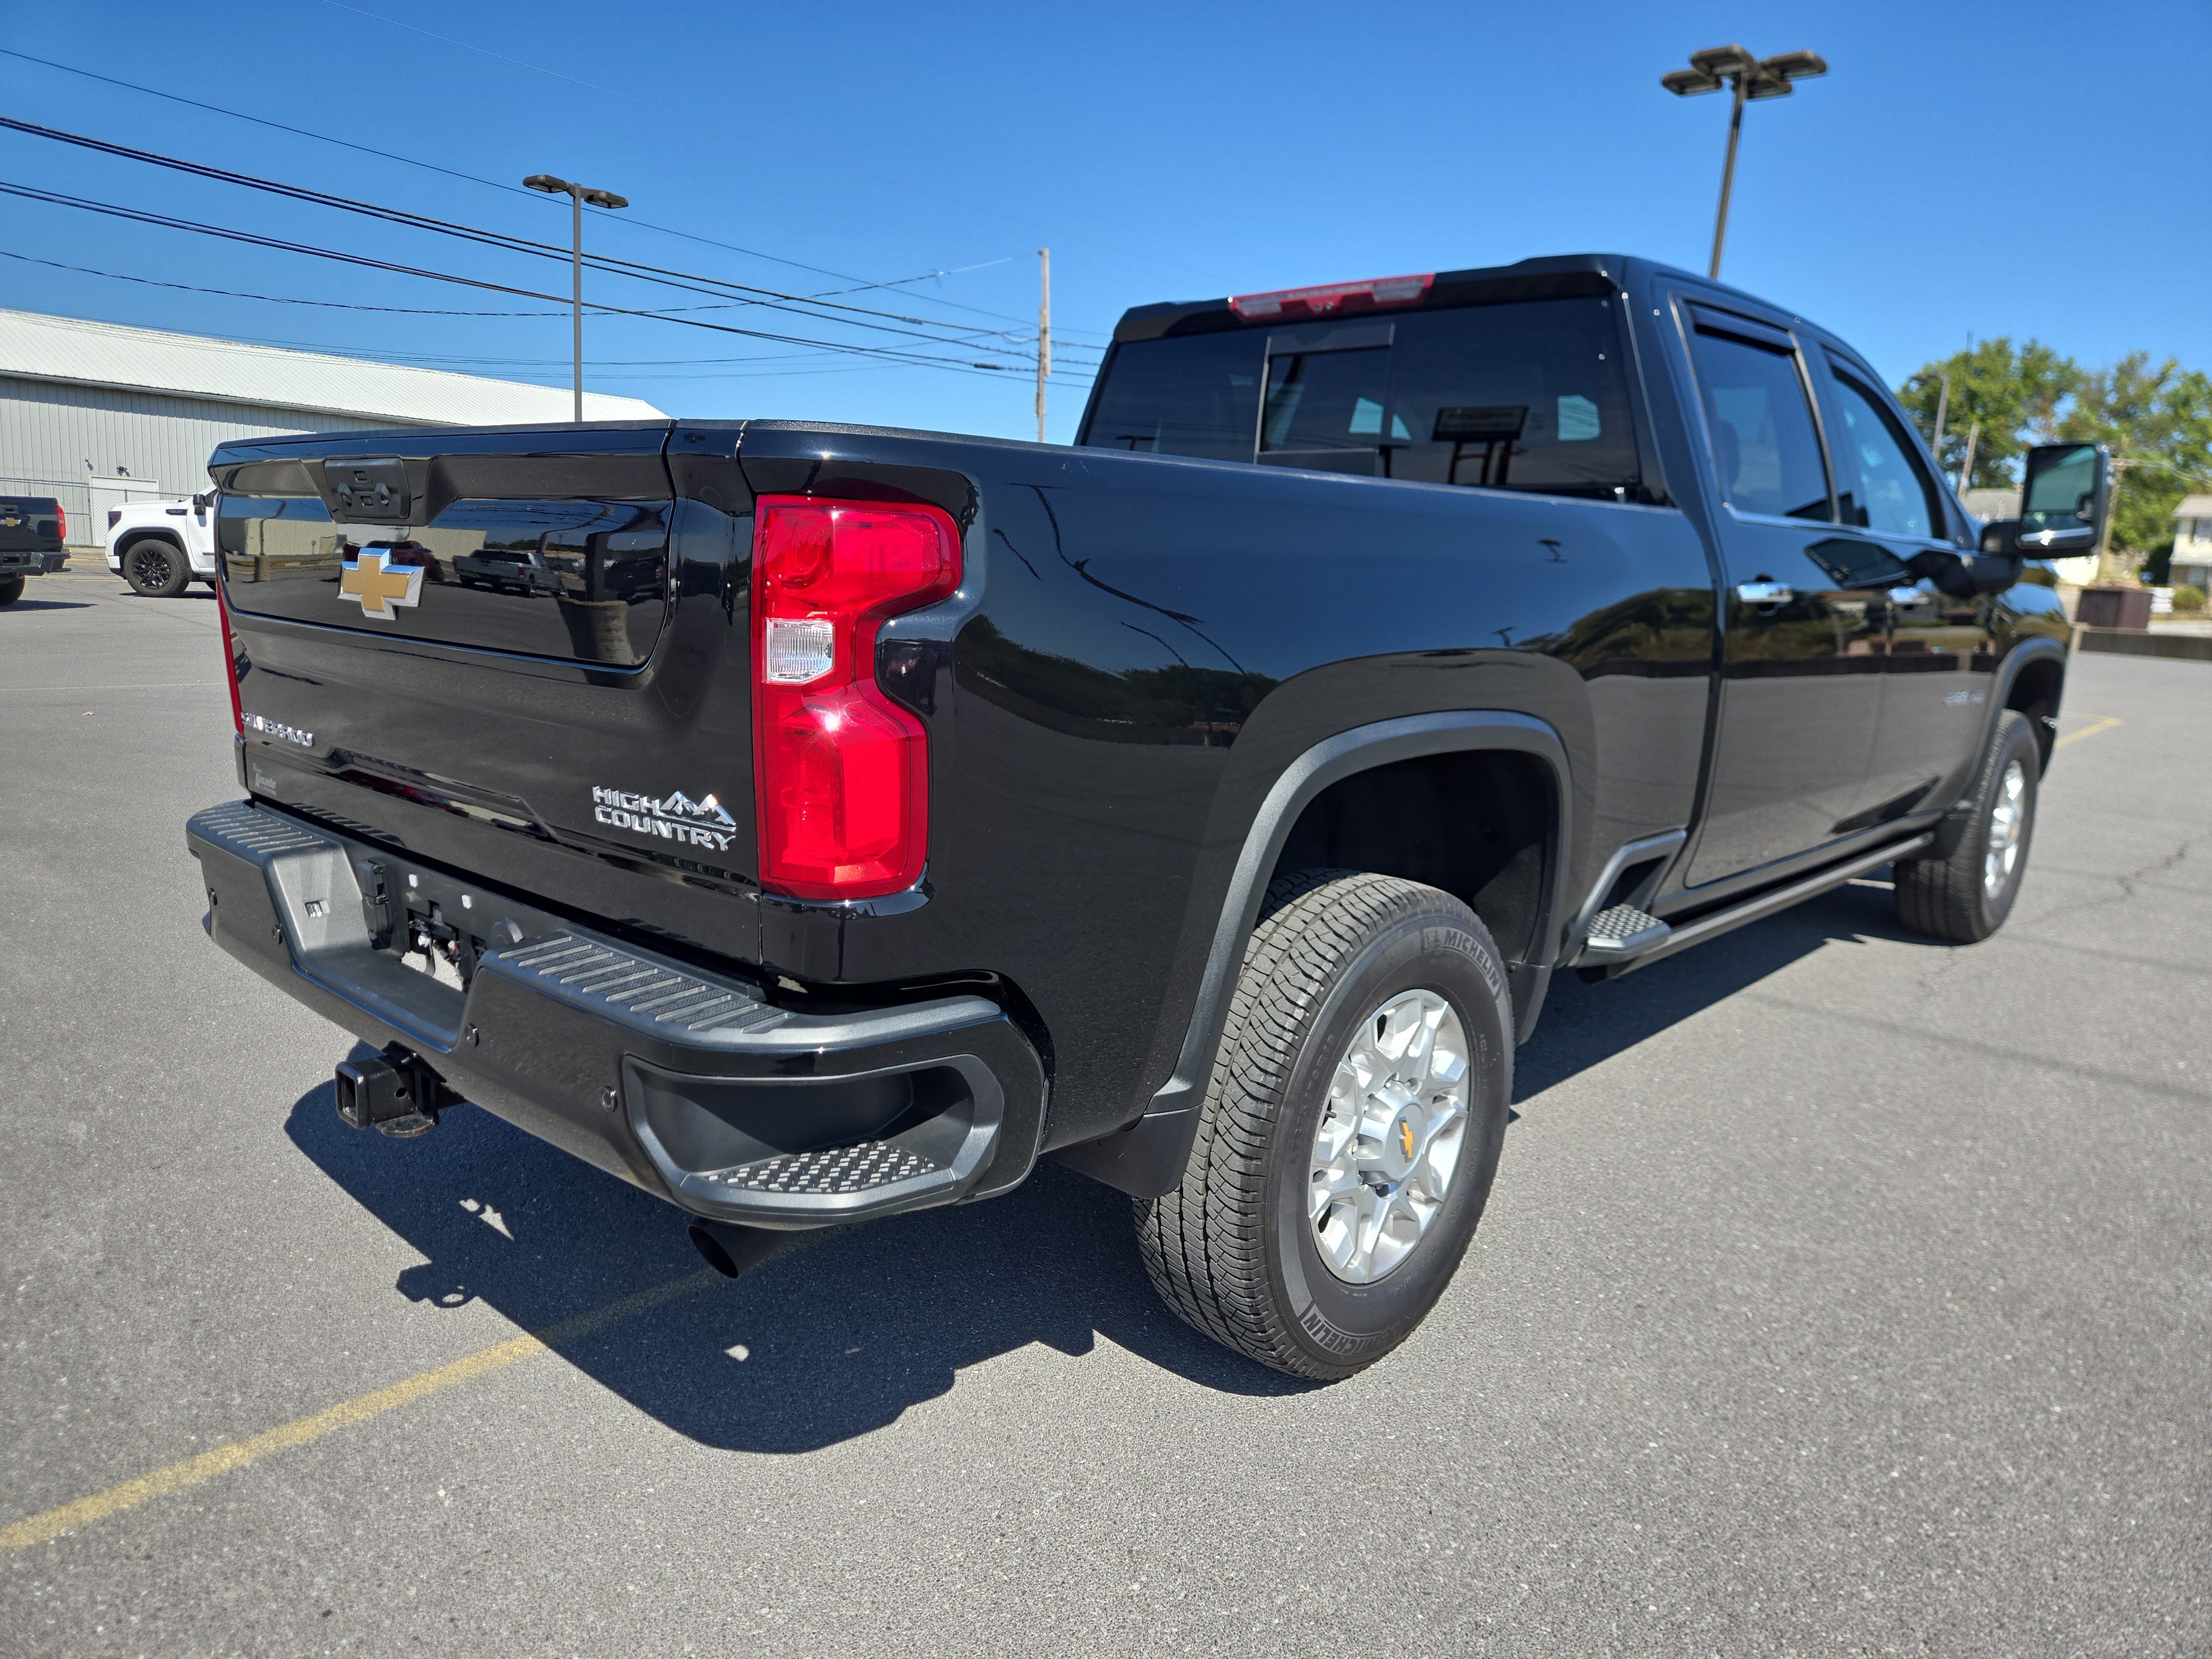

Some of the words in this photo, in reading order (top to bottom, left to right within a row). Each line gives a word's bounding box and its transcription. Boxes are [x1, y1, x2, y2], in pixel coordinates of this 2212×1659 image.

[592, 786, 663, 816] HIGH
[595, 805, 736, 851] COUNTRY
[1443, 929, 1499, 988] MICHELIN
